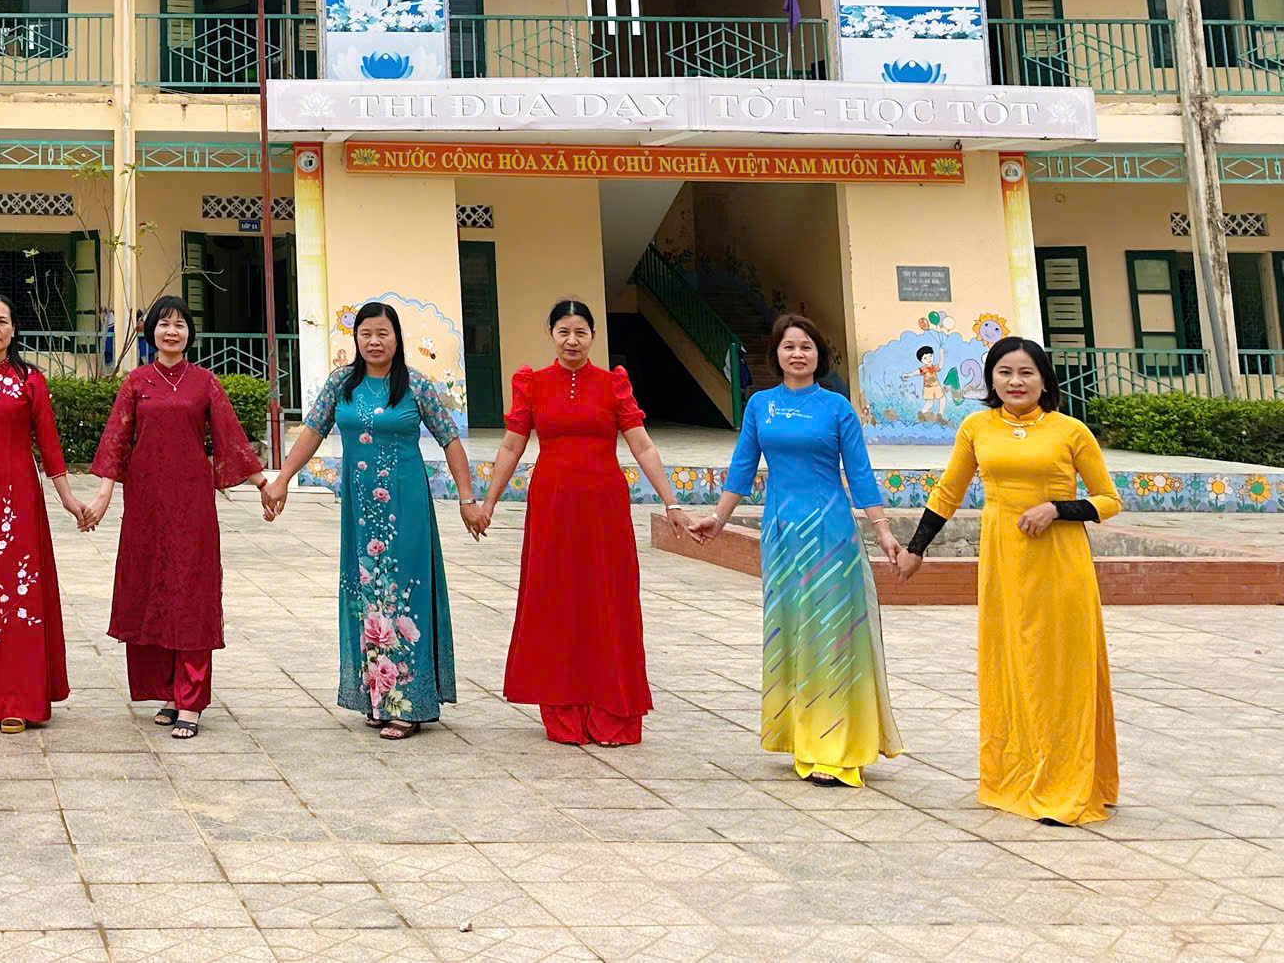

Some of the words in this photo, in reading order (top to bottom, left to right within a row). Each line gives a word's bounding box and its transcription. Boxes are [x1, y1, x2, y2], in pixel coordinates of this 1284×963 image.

[349, 93, 438, 119] THI
[451, 93, 560, 119] ĐUA
[573, 92, 680, 125] DẠY
[710, 85, 807, 121] TỐT
[836, 97, 936, 130] HỌC
[948, 90, 1040, 127] TỐT
[384, 147, 437, 169] NƯỚC
[441, 147, 494, 172] CỘNG
[498, 149, 538, 170] HÒA
[539, 150, 569, 171] XÃ
[572, 150, 609, 175] HỘI
[613, 150, 654, 173] CHỦ
[658, 152, 722, 174] NGHĨA
[724, 152, 770, 177] VIỆT
[774, 157, 817, 175] NAM
[820, 153, 878, 176] MUÔN
[883, 154, 928, 176] NĂM
